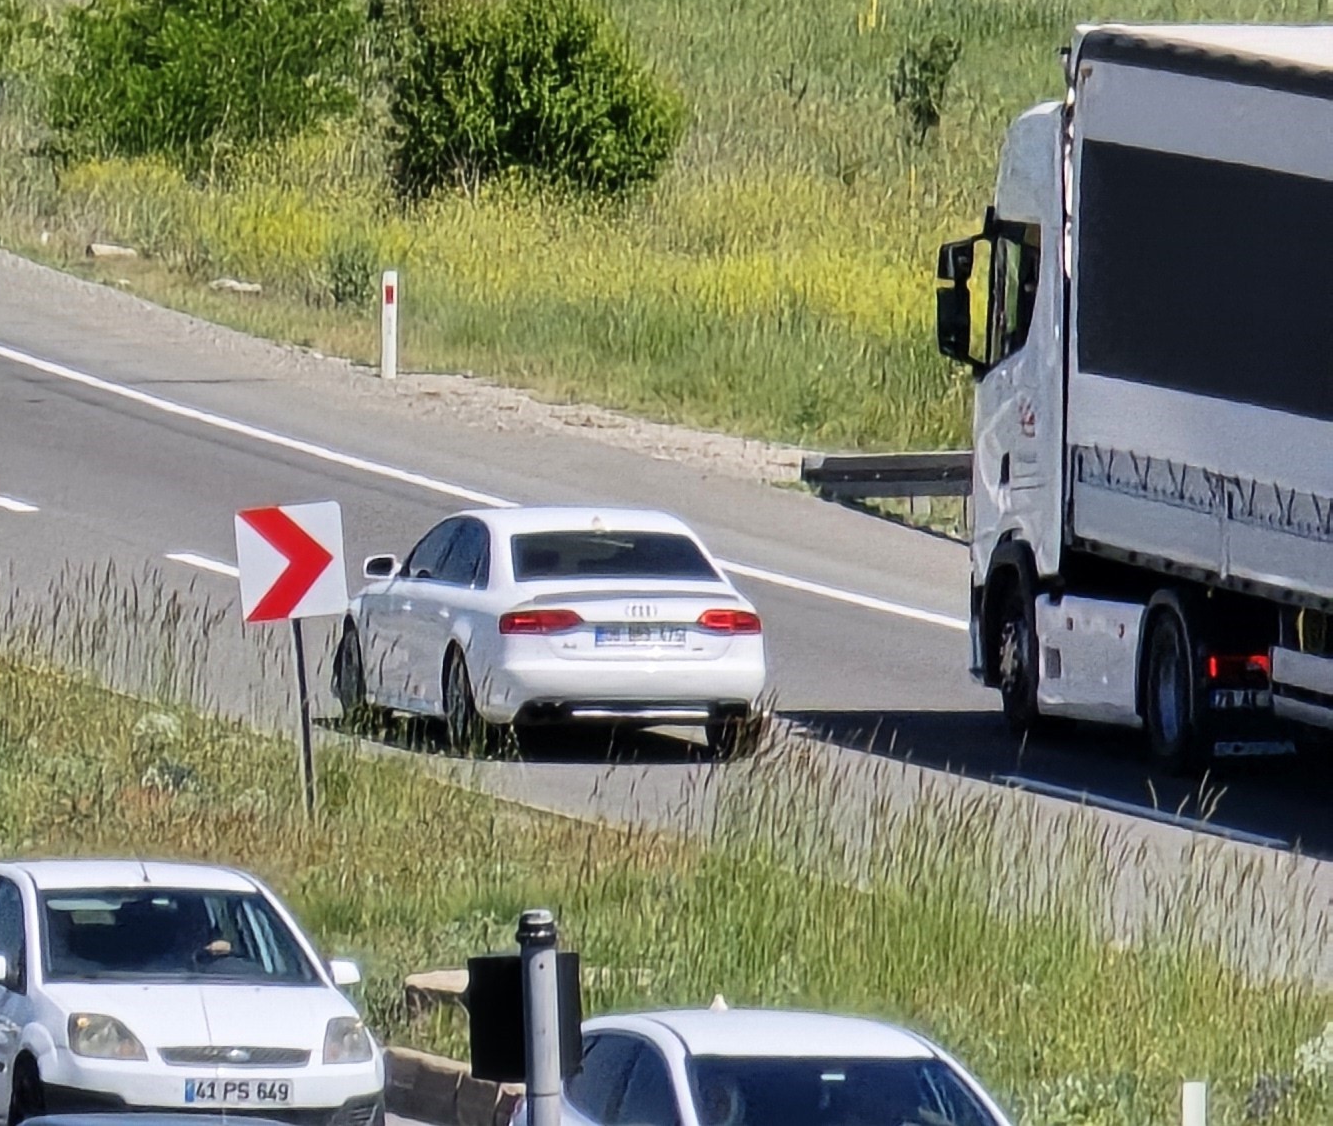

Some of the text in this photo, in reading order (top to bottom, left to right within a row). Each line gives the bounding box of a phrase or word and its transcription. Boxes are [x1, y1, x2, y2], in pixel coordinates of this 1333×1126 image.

[196, 1082, 289, 1101] 41 PS 649
